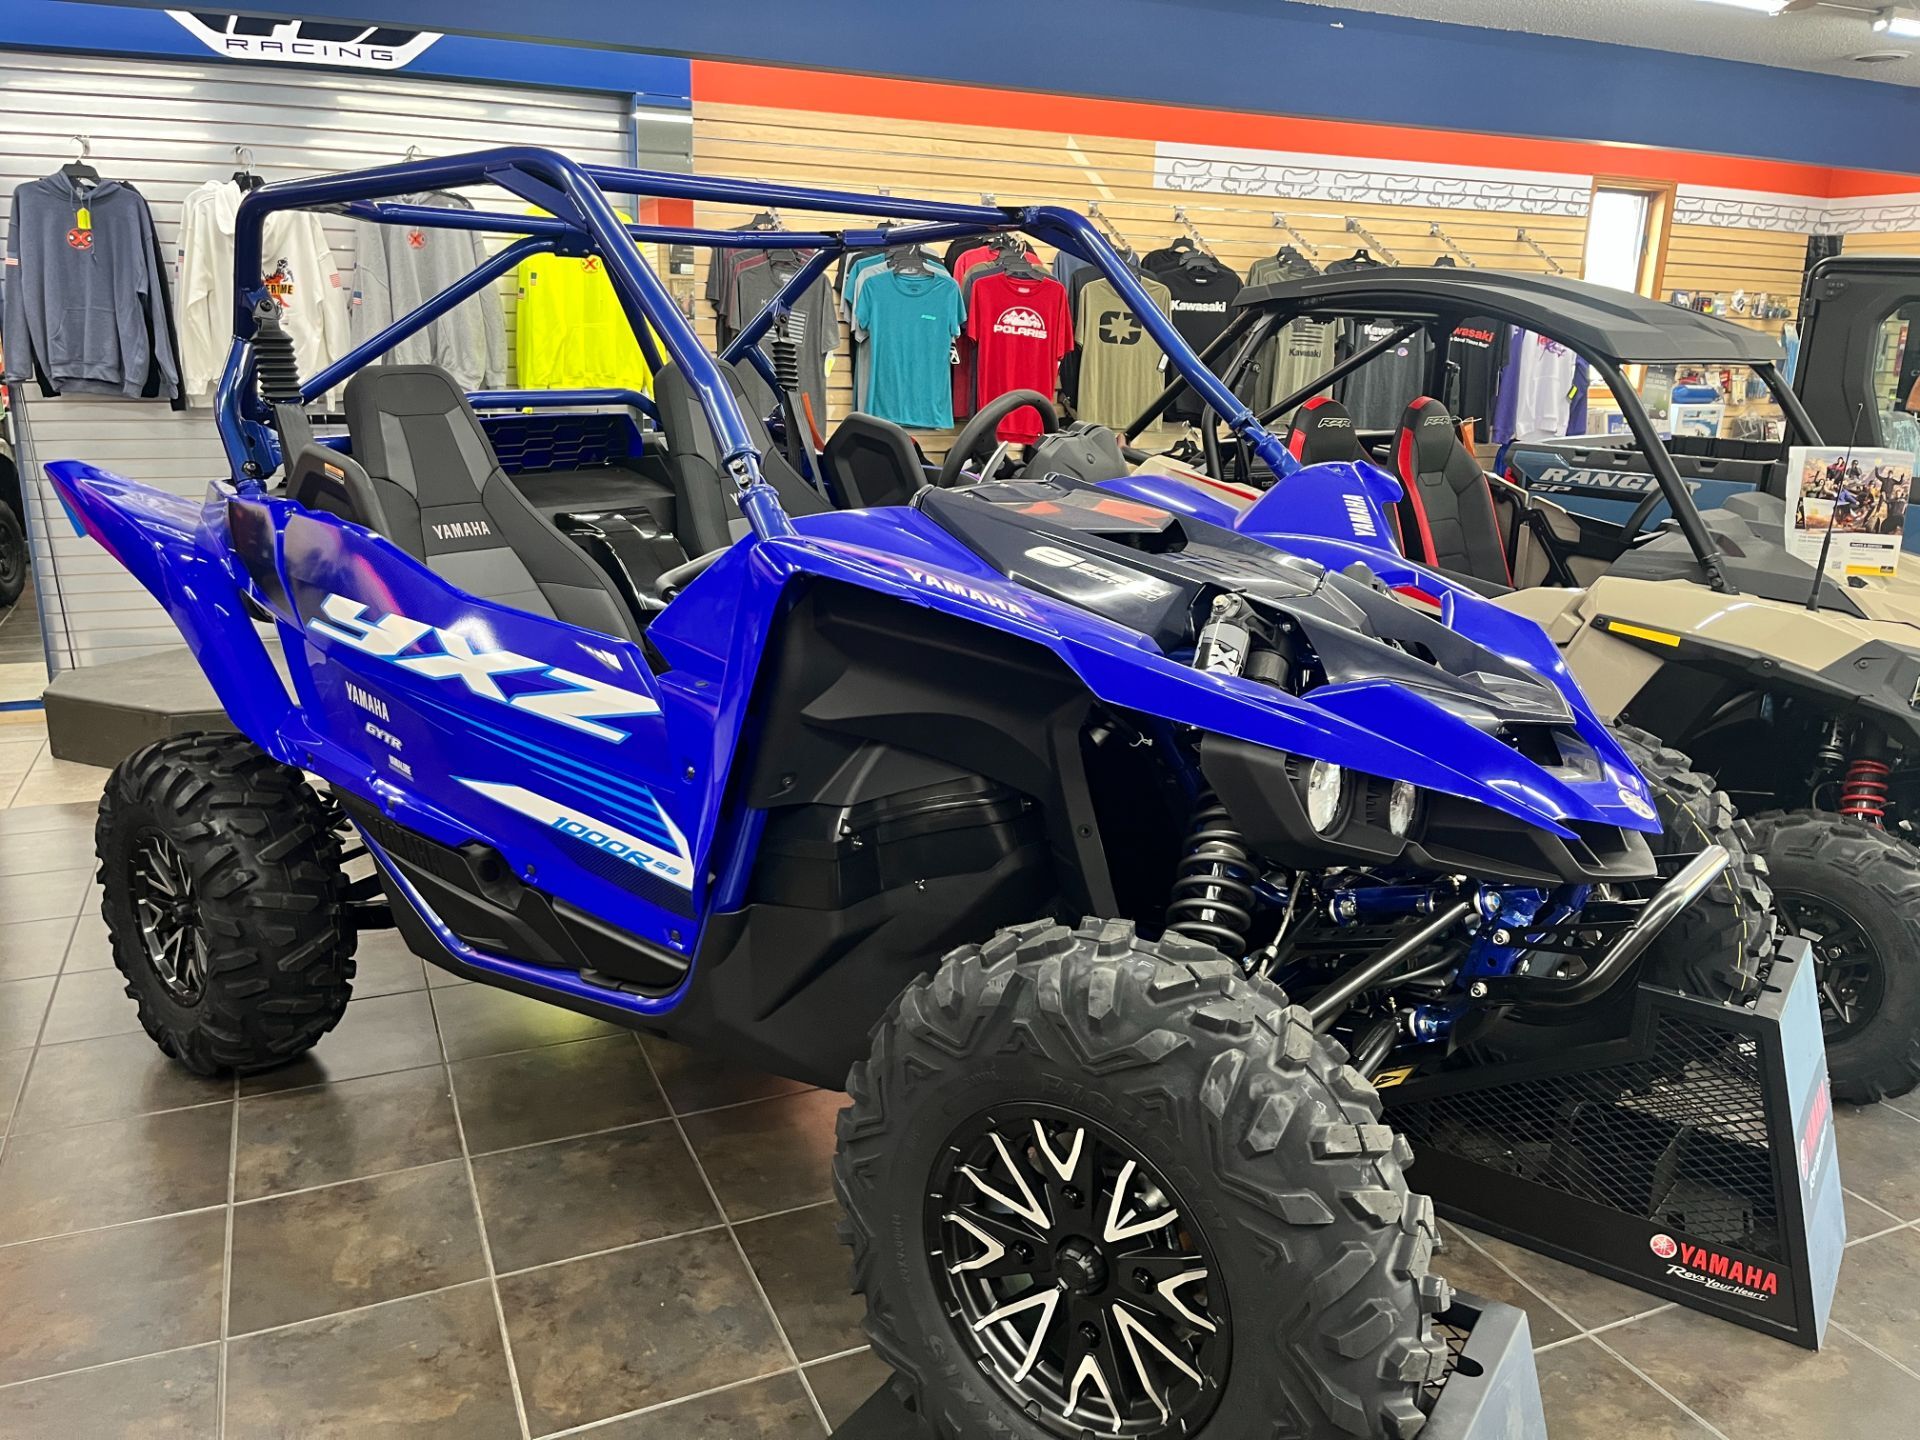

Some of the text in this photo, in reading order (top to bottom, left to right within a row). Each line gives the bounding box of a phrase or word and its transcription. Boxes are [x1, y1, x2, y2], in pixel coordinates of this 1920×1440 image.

[225, 38, 394, 62] RACING
[1170, 299, 1227, 313] Kawasaki
[993, 323, 1048, 340] POLARIS
[1527, 482, 1573, 493] SP
[431, 520, 492, 540] YAMAHA
[1342, 493, 1378, 537] YAMAHA
[903, 567, 1028, 618] YAMAHA
[307, 592, 665, 744] YXZ
[344, 680, 391, 723] YAMAHA
[364, 721, 404, 751] GYTR
[1665, 1263, 1769, 1302] Revs Your Heart
[1680, 1241, 1778, 1296] YAMAHA
